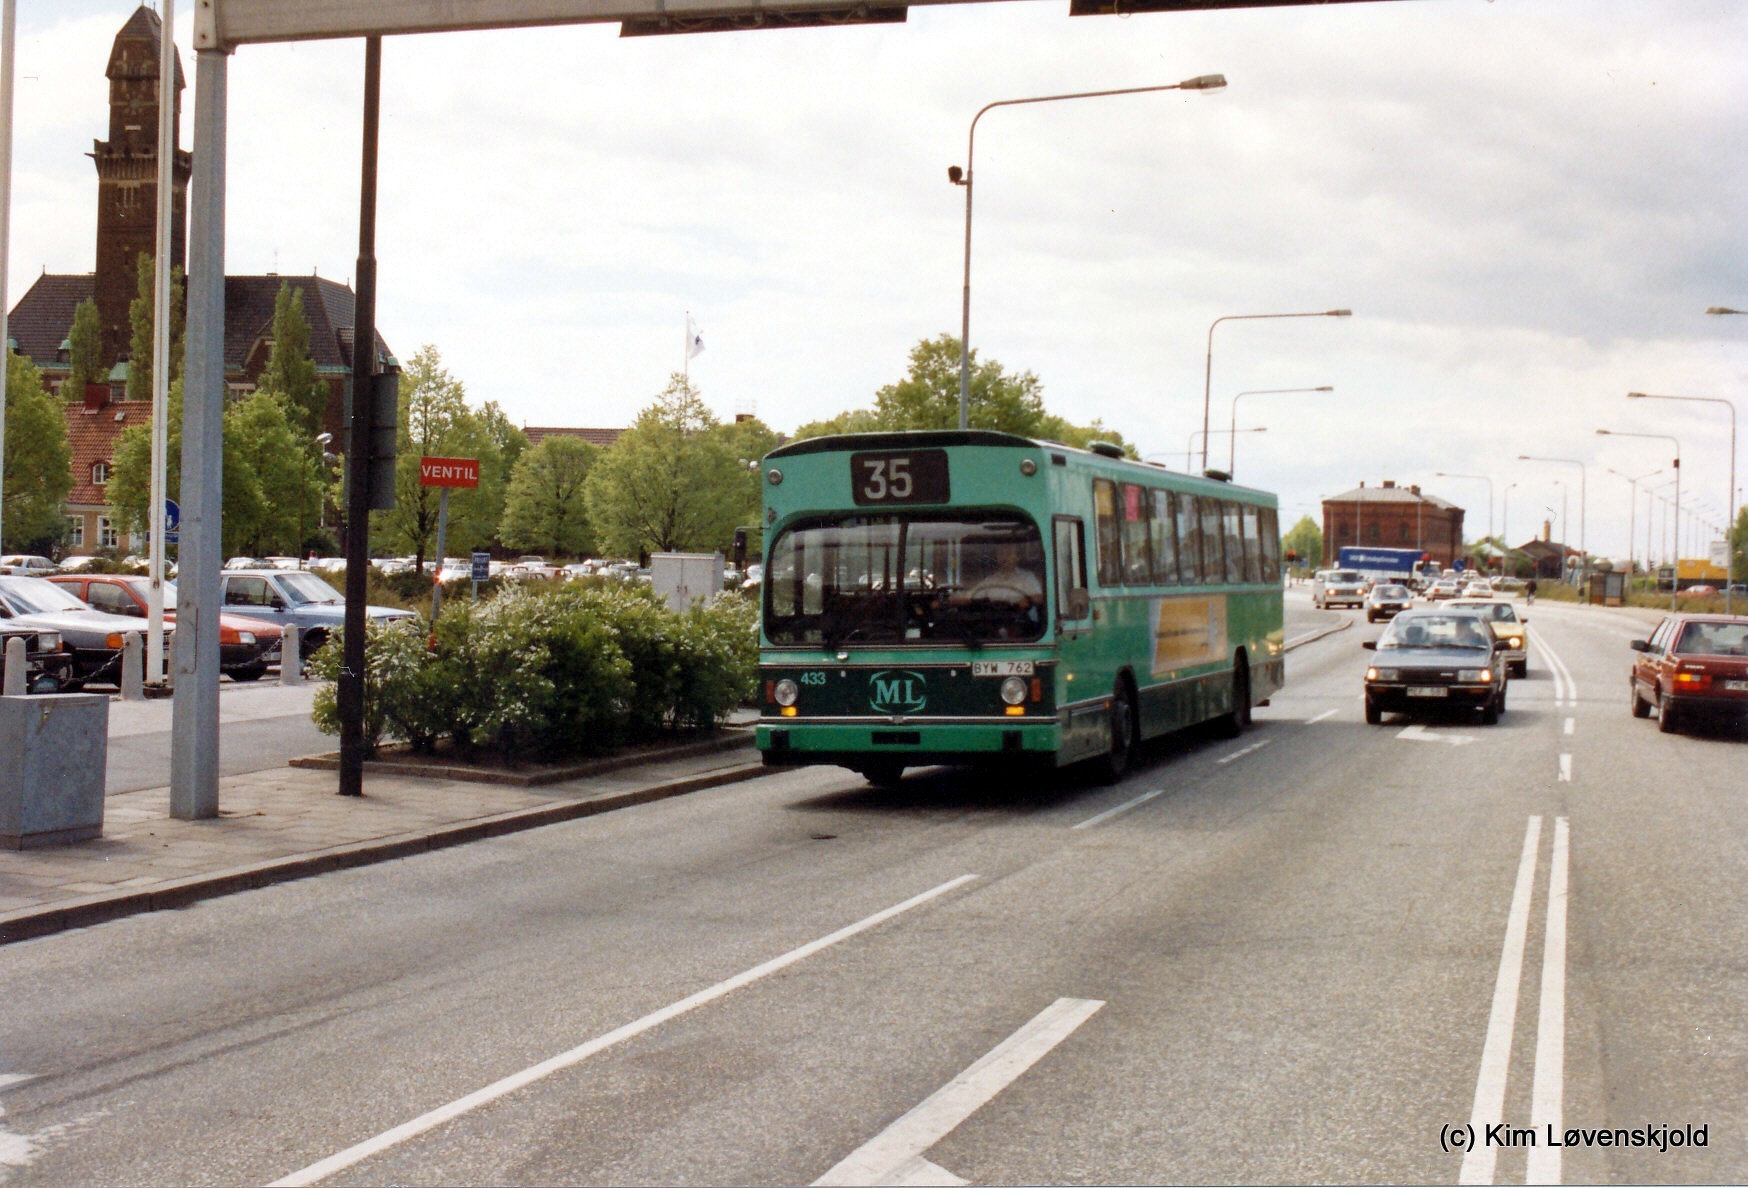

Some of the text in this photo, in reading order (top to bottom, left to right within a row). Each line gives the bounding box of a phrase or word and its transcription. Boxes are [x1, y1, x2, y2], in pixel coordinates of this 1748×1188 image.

[421, 465, 477, 480] VENTIL
[864, 460, 912, 498] 35
[974, 662, 1032, 674] BYW 762
[800, 672, 826, 685] 433
[876, 679, 925, 704] ML
